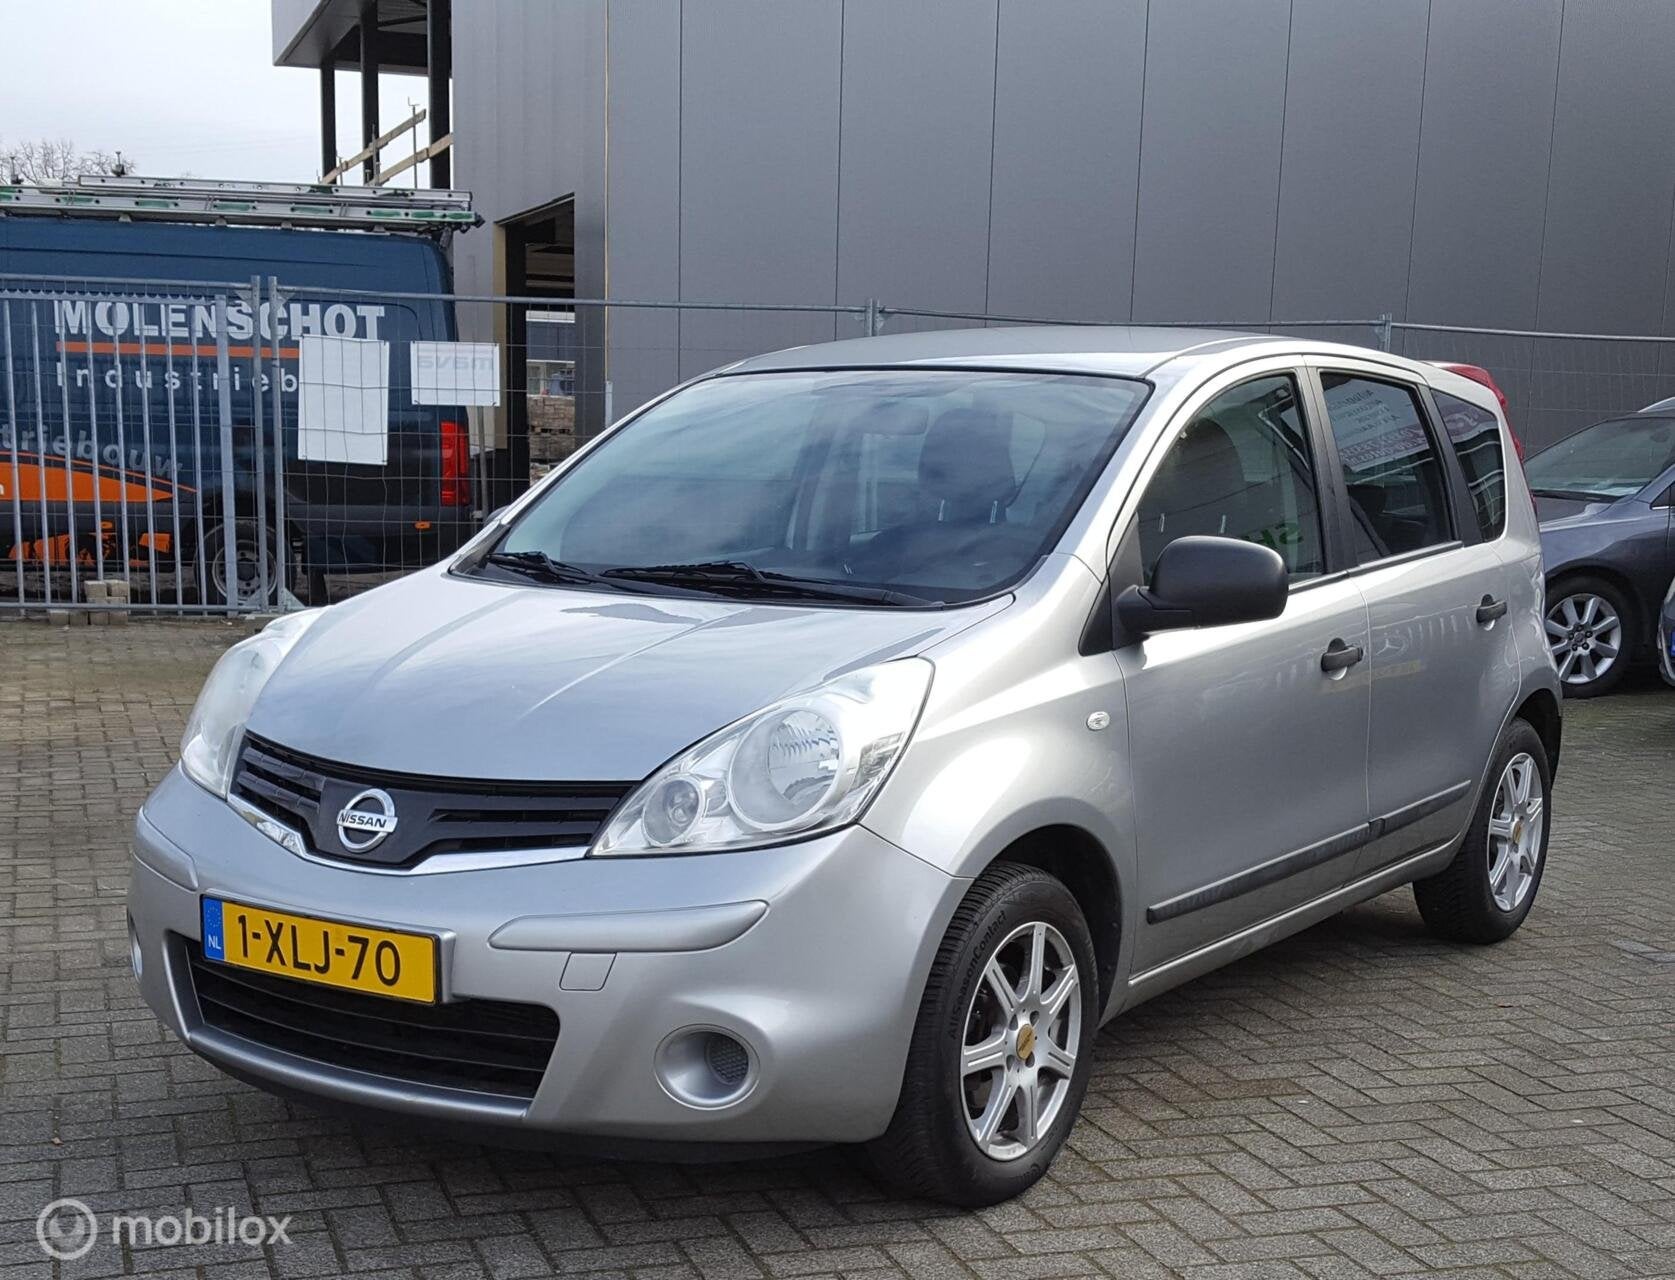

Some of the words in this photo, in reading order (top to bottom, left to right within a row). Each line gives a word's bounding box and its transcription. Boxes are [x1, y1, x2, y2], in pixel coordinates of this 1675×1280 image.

[54, 300, 386, 341] MOLENSCHOT
[338, 811, 388, 829] NISSAN
[207, 934, 222, 950] NL
[237, 914, 401, 987] 1-XLJ-70
